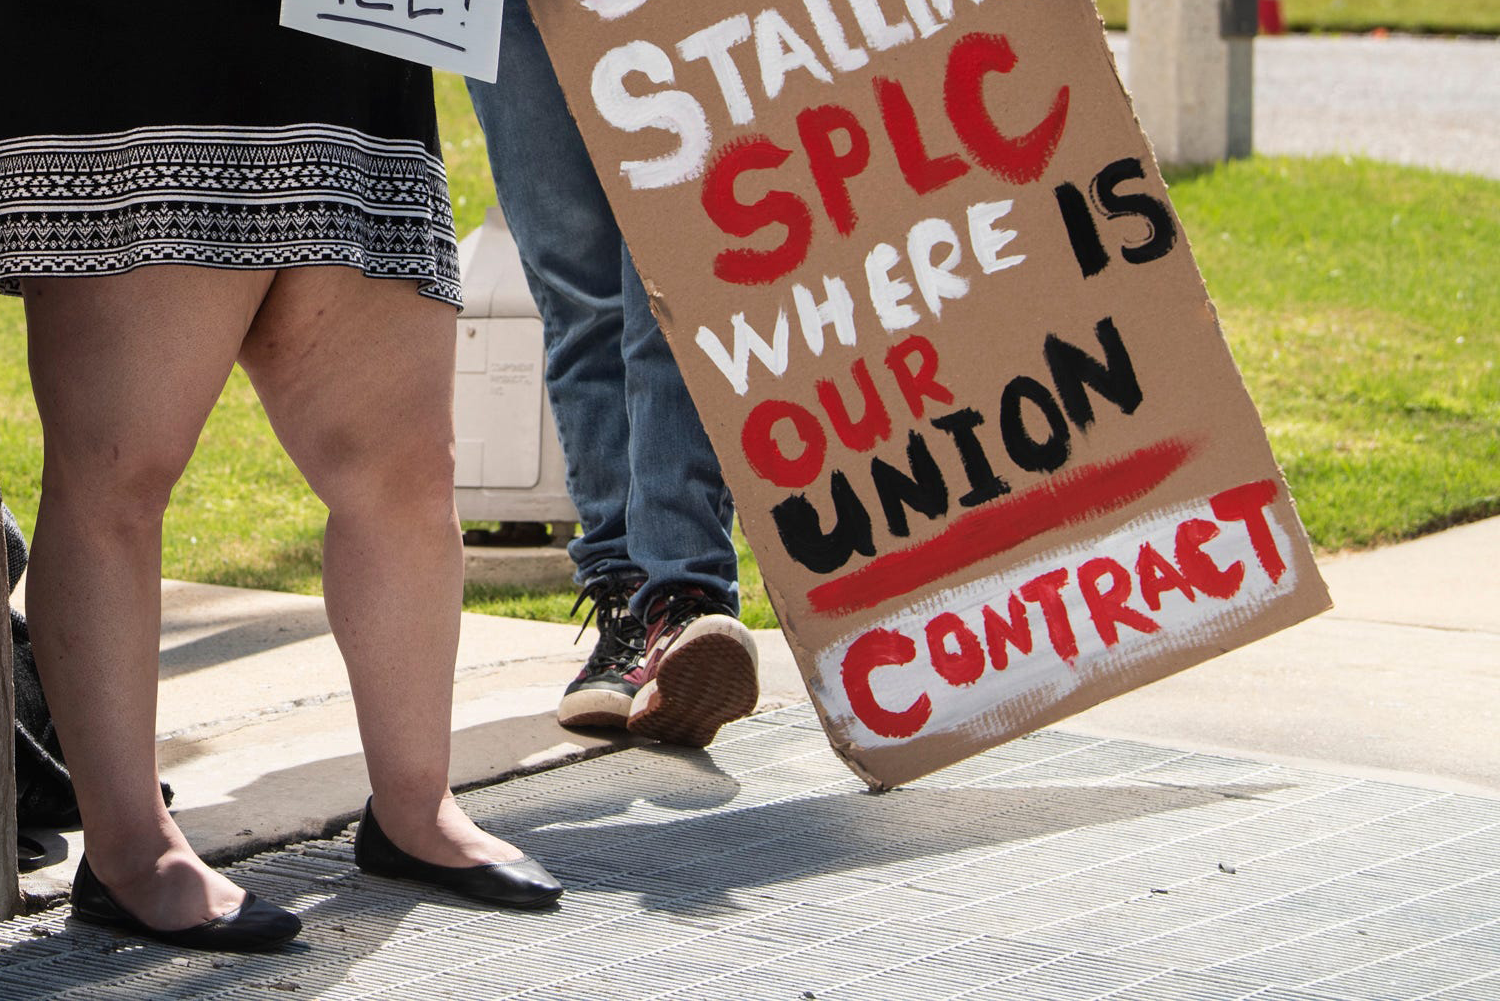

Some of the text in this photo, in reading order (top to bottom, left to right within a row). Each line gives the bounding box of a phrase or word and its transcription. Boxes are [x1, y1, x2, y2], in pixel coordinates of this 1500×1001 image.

[696, 157, 1177, 397] WHERE IS
[701, 32, 1070, 286] SPLC
[741, 334, 955, 489] OUR
[770, 316, 1144, 574] UNION
[840, 480, 1287, 740] CONTRACT
